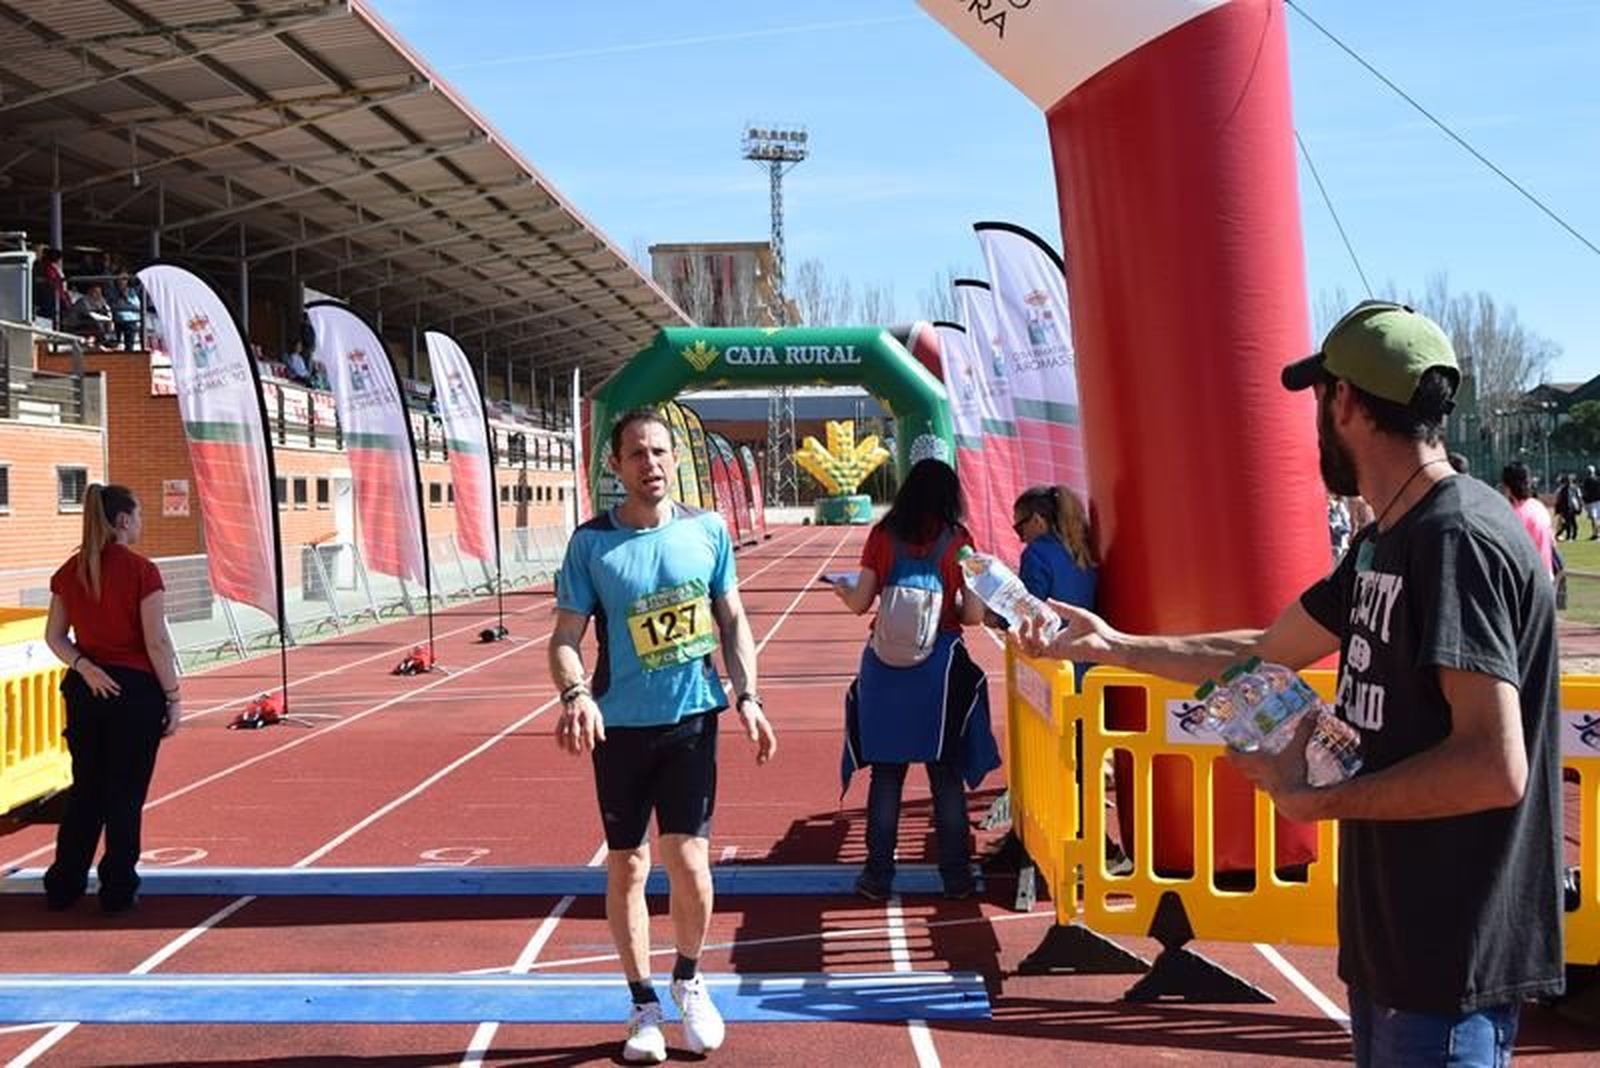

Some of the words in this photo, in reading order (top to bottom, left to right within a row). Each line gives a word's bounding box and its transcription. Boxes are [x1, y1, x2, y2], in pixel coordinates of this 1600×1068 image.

[725, 345, 778, 365] CAJA
[785, 345, 861, 365] RURAL
[640, 604, 697, 646] 127
